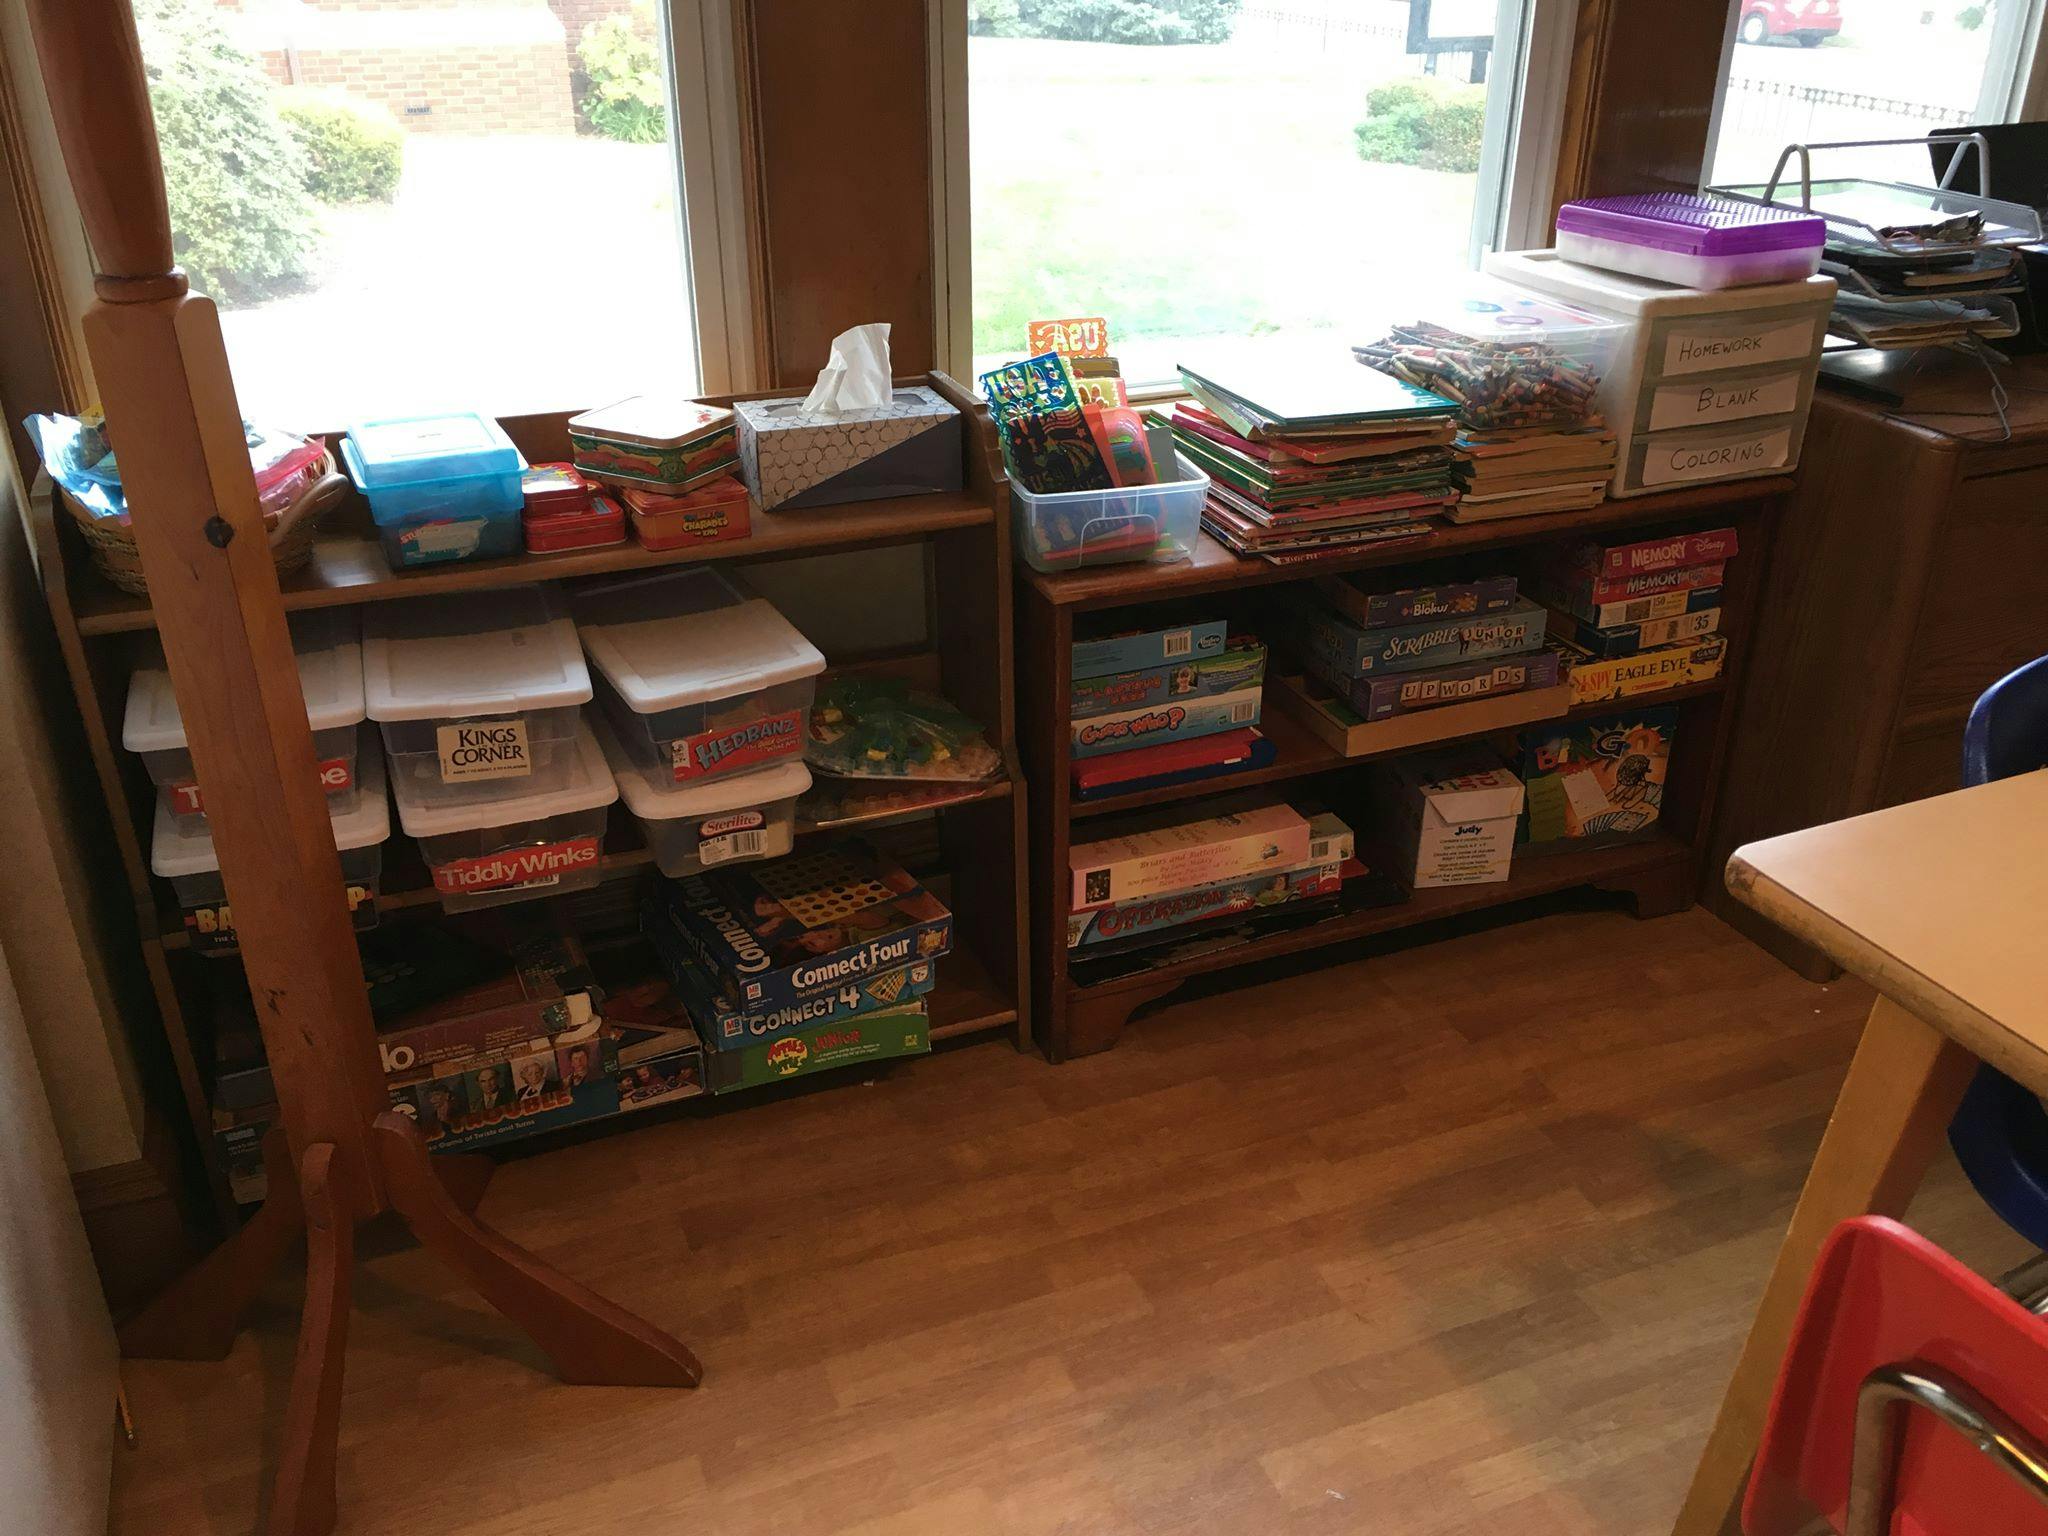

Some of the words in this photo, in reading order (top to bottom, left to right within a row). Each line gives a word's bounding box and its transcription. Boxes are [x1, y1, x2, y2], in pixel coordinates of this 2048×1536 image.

[1679, 337, 1763, 362] HOMEWORK
[986, 361, 1049, 405] USA
[1697, 387, 1760, 412] BLANK
[1670, 442, 1764, 471] COLORING
[1631, 541, 1687, 568] MEMORY
[1695, 537, 1725, 553] Disney
[1626, 569, 1683, 595] MEMORY
[1412, 602, 1449, 617] Blokus
[1694, 614, 1710, 632] 35
[1383, 626, 1459, 660] SCRABBLE
[1464, 624, 1524, 643] JUNIOR
[1403, 668, 1522, 698] UPWORDS
[1615, 663, 1658, 683] EAGLE
[1660, 657, 1688, 674] EYE
[458, 727, 517, 747] KINGS
[695, 719, 796, 771] HEDBANZ
[451, 745, 525, 766] CORNER
[707, 814, 756, 833] Sterilite
[1454, 825, 1483, 836] Judy
[440, 860, 517, 887] Tiddly
[520, 847, 597, 873] Winks
[791, 951, 868, 988] Connect
[869, 937, 911, 965] Four
[749, 995, 836, 1036] CONNECT
[838, 985, 860, 1009] 4
